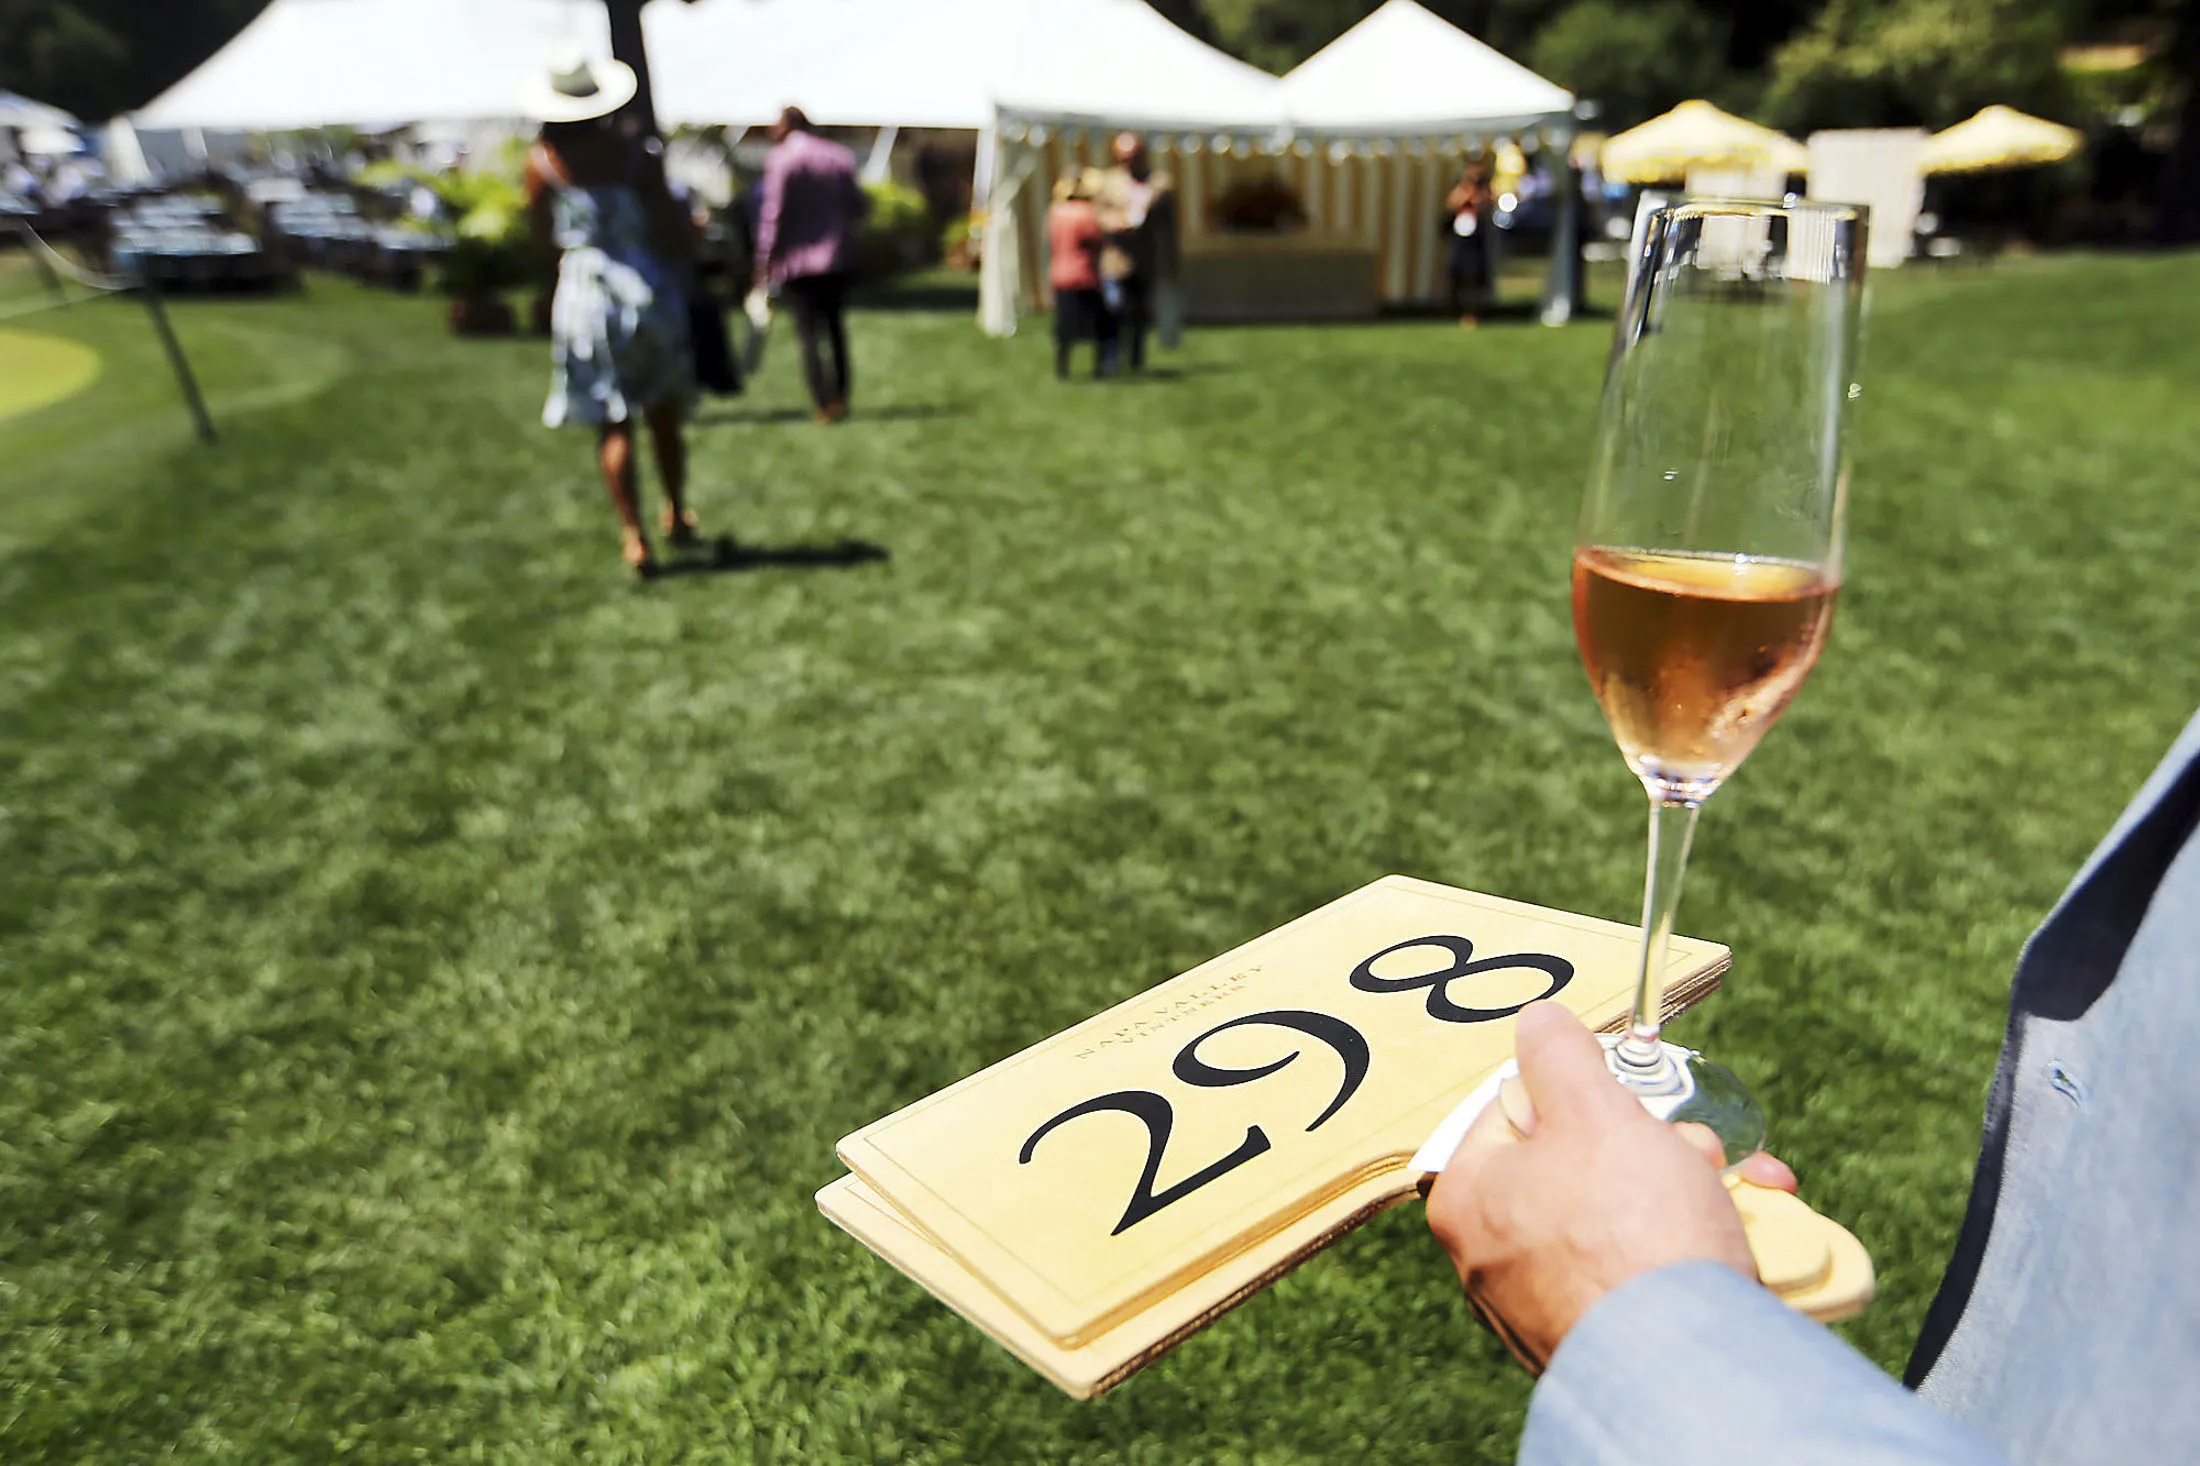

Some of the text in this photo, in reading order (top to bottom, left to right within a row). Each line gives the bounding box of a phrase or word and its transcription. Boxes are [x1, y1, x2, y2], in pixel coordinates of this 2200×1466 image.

[1018, 935, 1575, 1237] 298
[1076, 966, 1262, 1058] NAPA VALLEY
